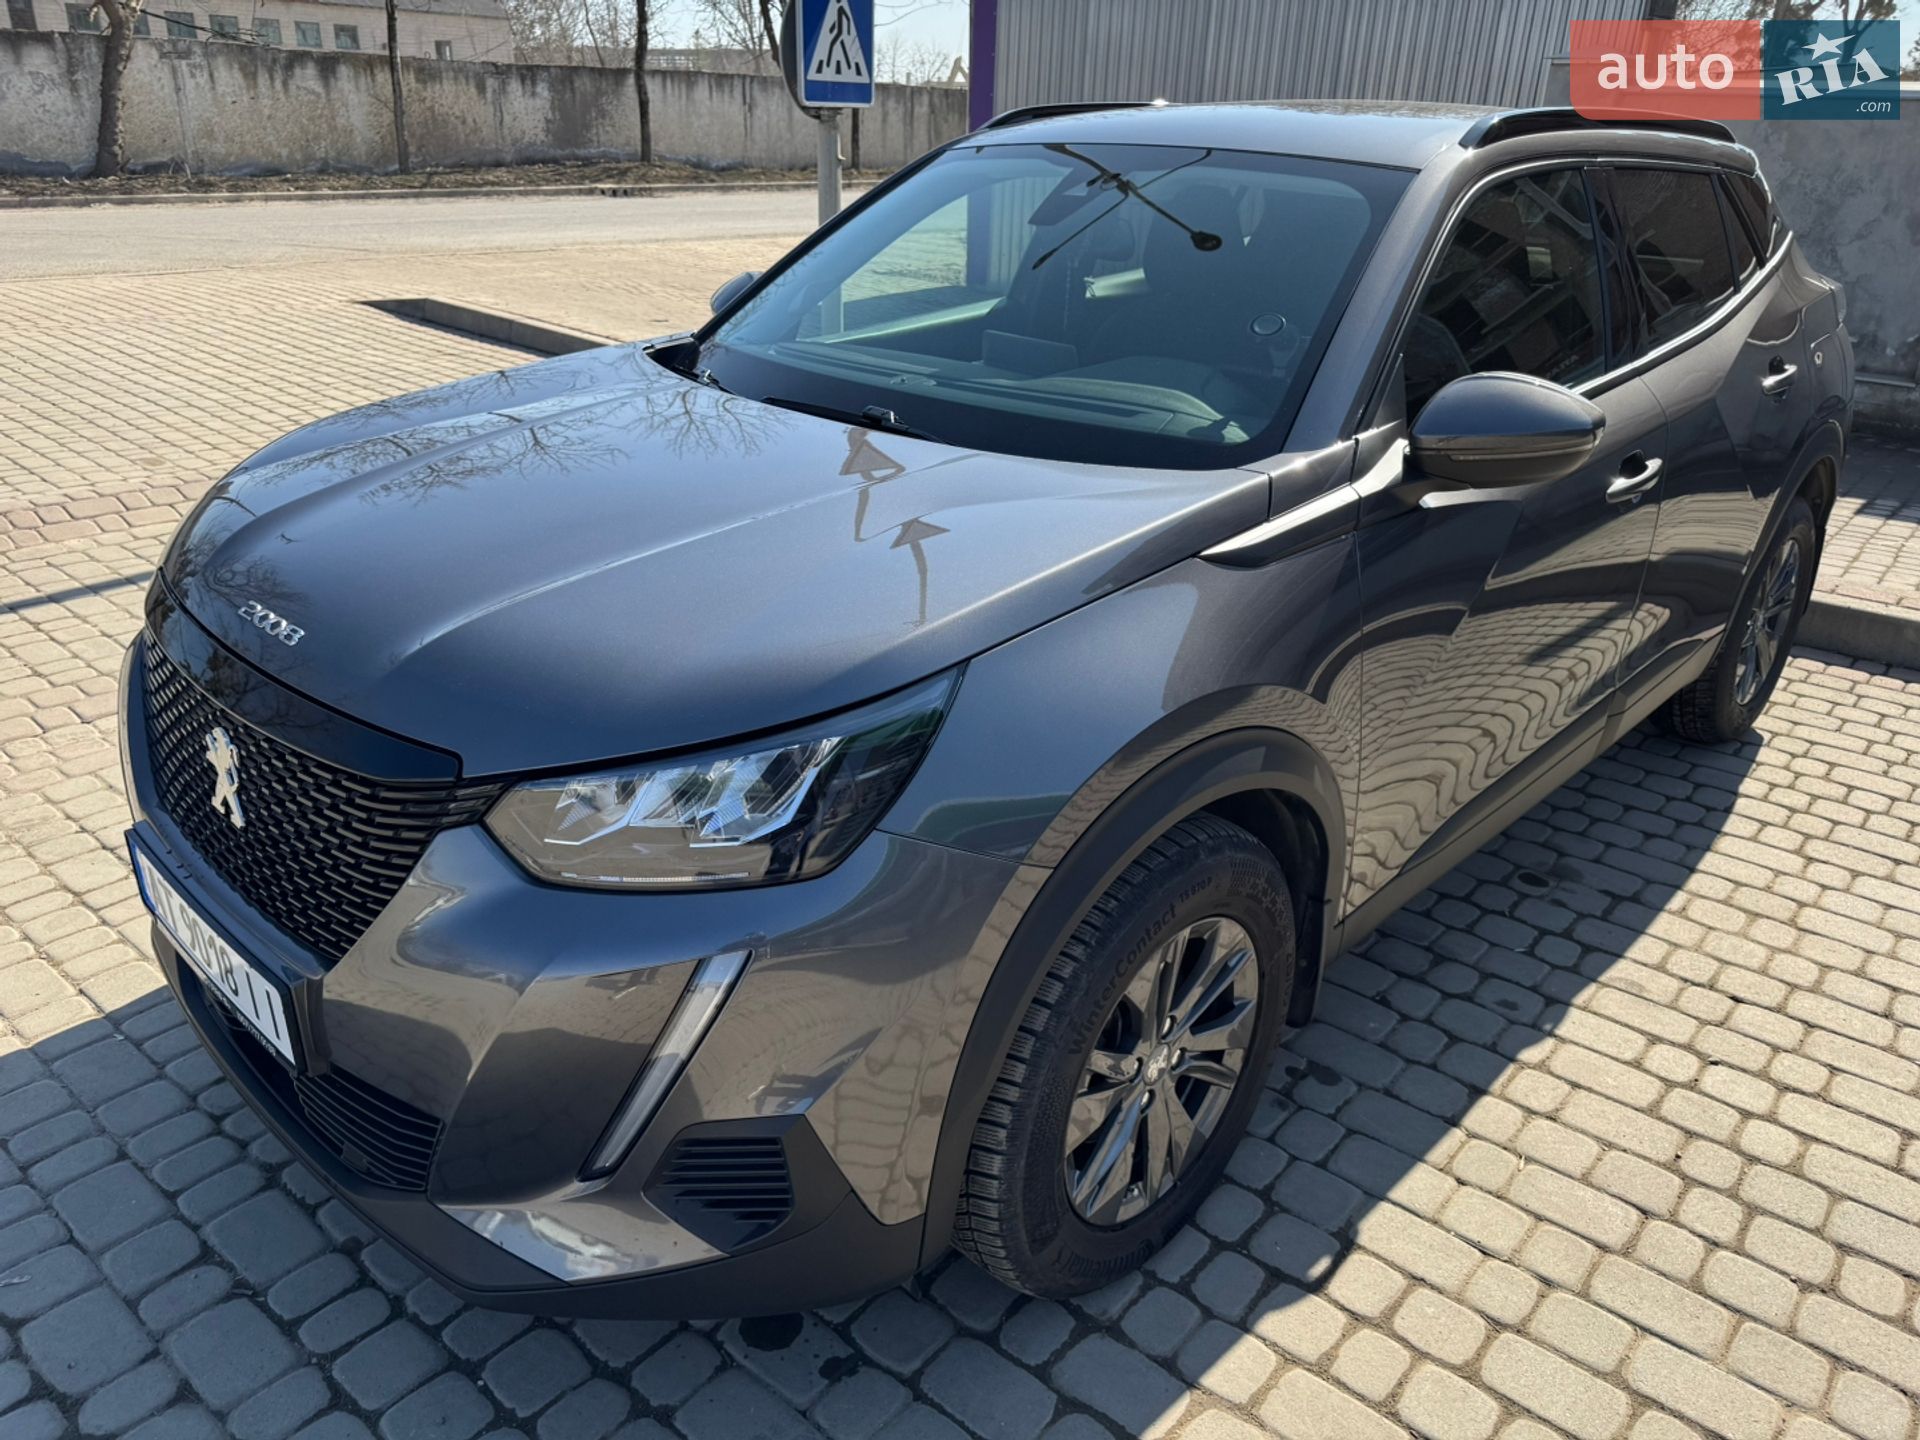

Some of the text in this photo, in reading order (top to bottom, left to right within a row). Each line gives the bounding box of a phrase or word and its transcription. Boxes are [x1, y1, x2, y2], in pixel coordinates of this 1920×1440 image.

[238, 600, 305, 646] 2008
[180, 902, 239, 997] 9018
[1067, 902, 1177, 1055] WinterContact
